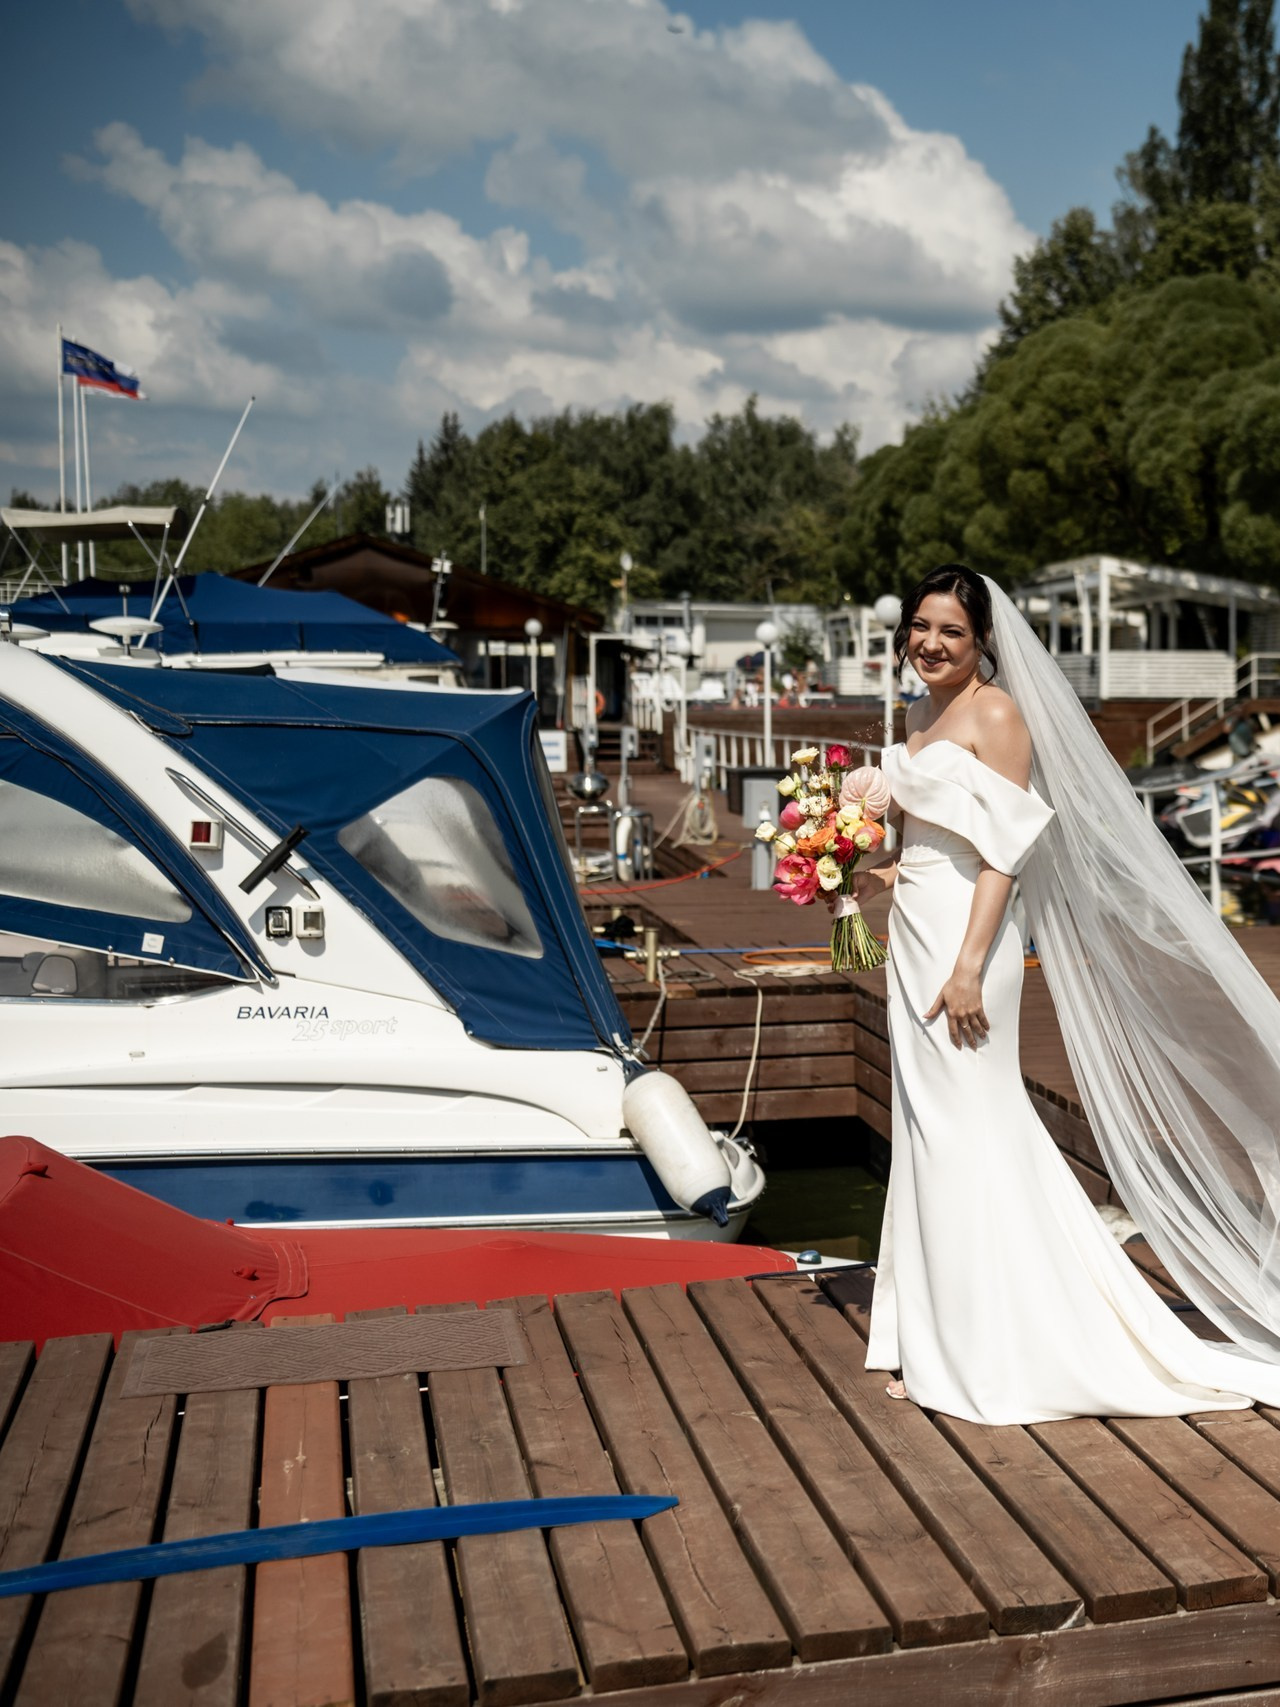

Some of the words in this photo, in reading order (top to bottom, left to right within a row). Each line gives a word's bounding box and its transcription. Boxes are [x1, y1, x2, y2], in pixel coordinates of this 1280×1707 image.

[236, 1005, 329, 1020] BAVARIA
[291, 1019, 329, 1042] 25
[330, 1015, 398, 1041] sport
